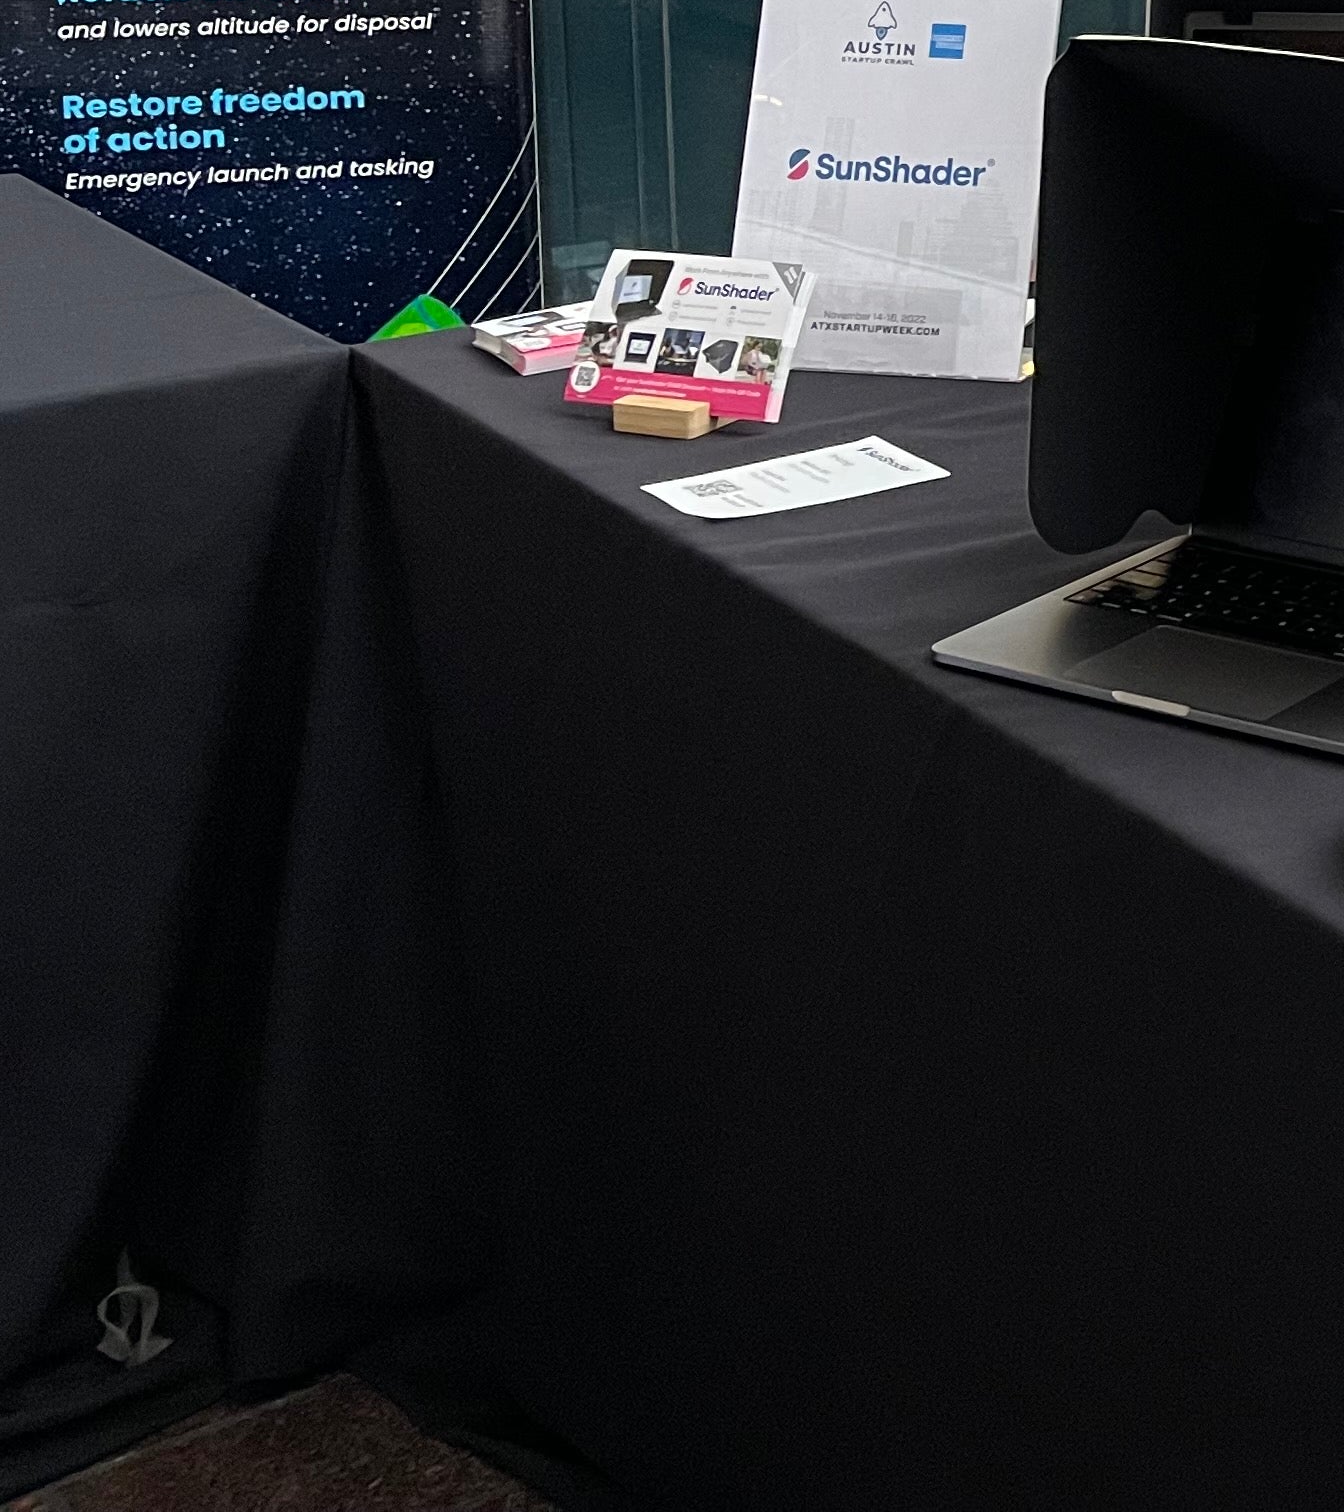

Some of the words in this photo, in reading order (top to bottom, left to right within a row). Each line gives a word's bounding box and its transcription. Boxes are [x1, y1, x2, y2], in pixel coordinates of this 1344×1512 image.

[57, 21, 106, 40] and
[114, 19, 191, 38] lowers
[197, 17, 290, 36] altitude
[296, 16, 329, 34] for
[334, 13, 433, 36] disposal
[843, 41, 915, 56] AUSTIN
[63, 93, 202, 119] Restore
[209, 88, 365, 114] freedom
[64, 126, 101, 154] of
[107, 125, 226, 152] action
[65, 169, 201, 193] Emergency
[207, 165, 289, 185] launch
[295, 161, 343, 180] and
[349, 158, 434, 180] tasking
[810, 321, 940, 336] ATXSTARTUPWEEK.COM
